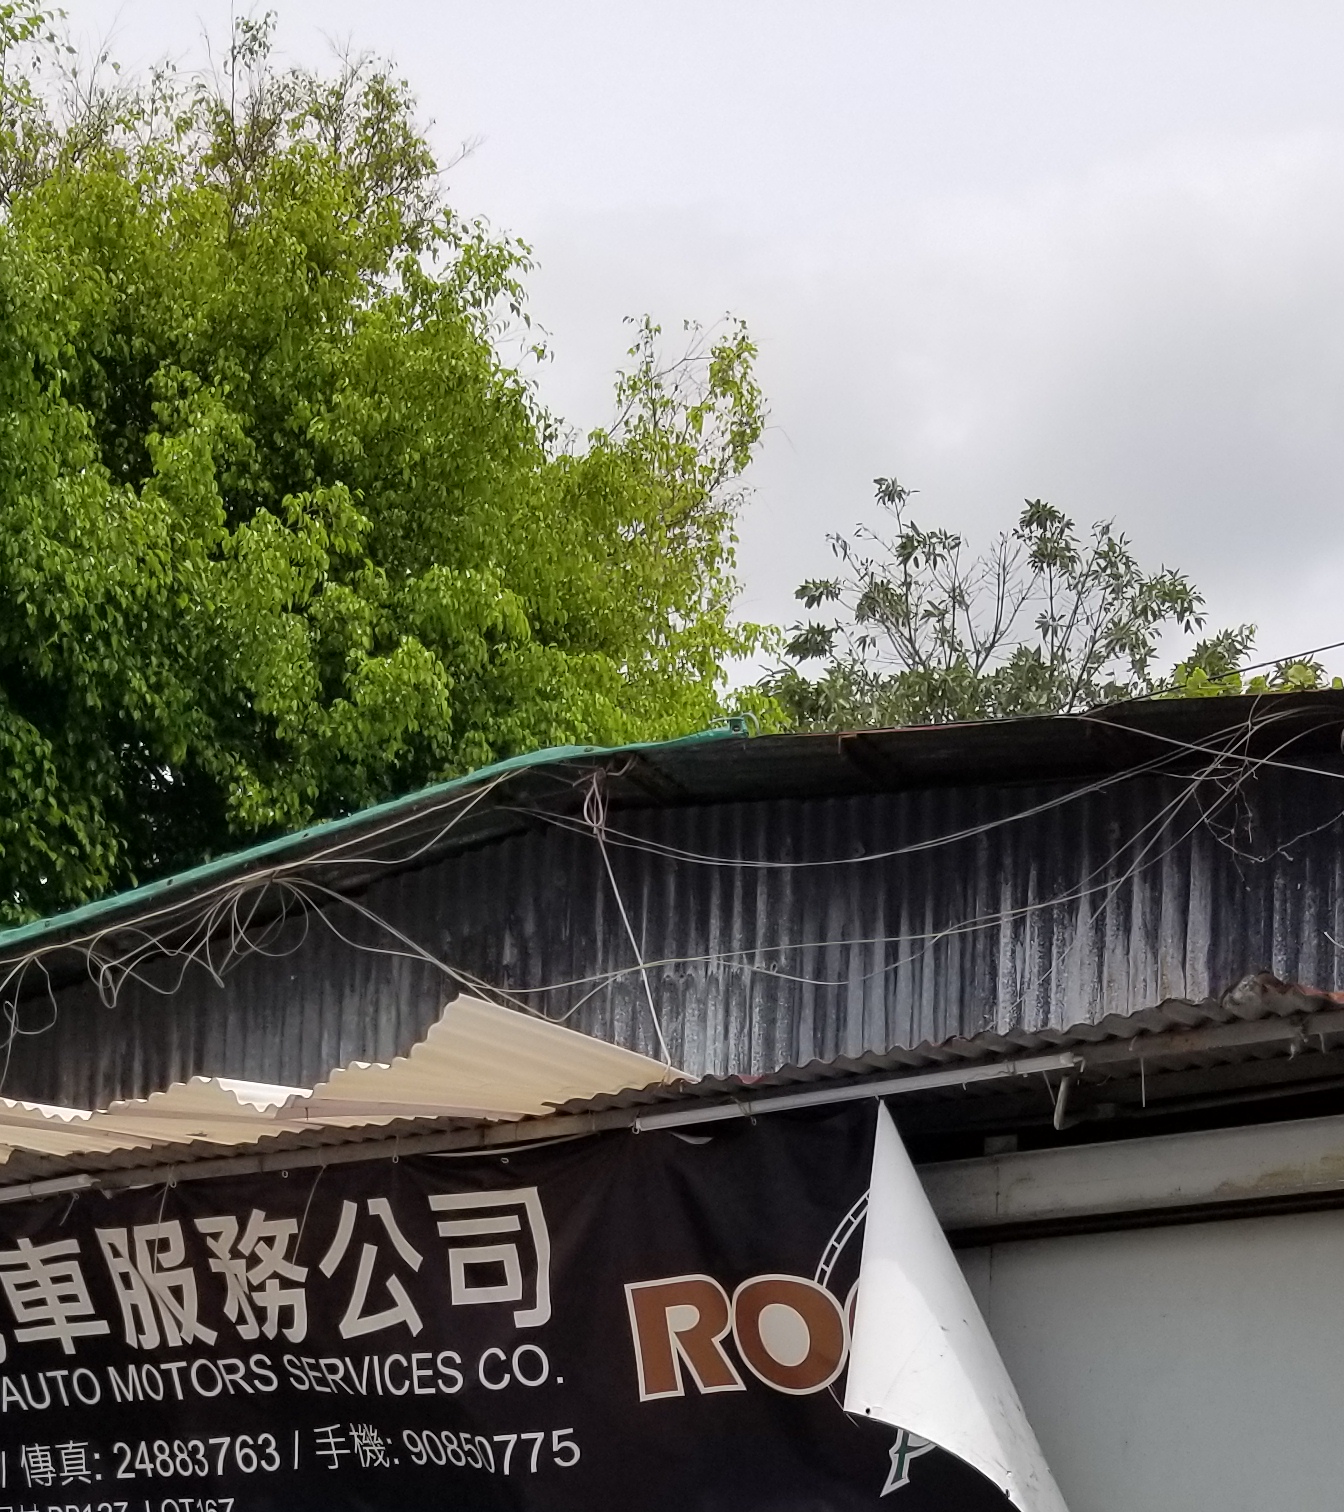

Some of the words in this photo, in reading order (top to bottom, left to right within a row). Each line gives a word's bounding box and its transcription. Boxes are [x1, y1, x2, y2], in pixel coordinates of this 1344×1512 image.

[624, 1273, 860, 1401] RO
[1, 1368, 101, 1412] AUTO
[108, 1353, 278, 1402] MOTORS
[283, 1349, 464, 1396] SERVICES
[478, 1344, 564, 1391] CO.
[20, 1440, 102, 1487] 傳真:
[113, 1432, 280, 1479] 24883763
[314, 1423, 400, 1469] 手機:
[402, 1428, 582, 1476] 90850775
